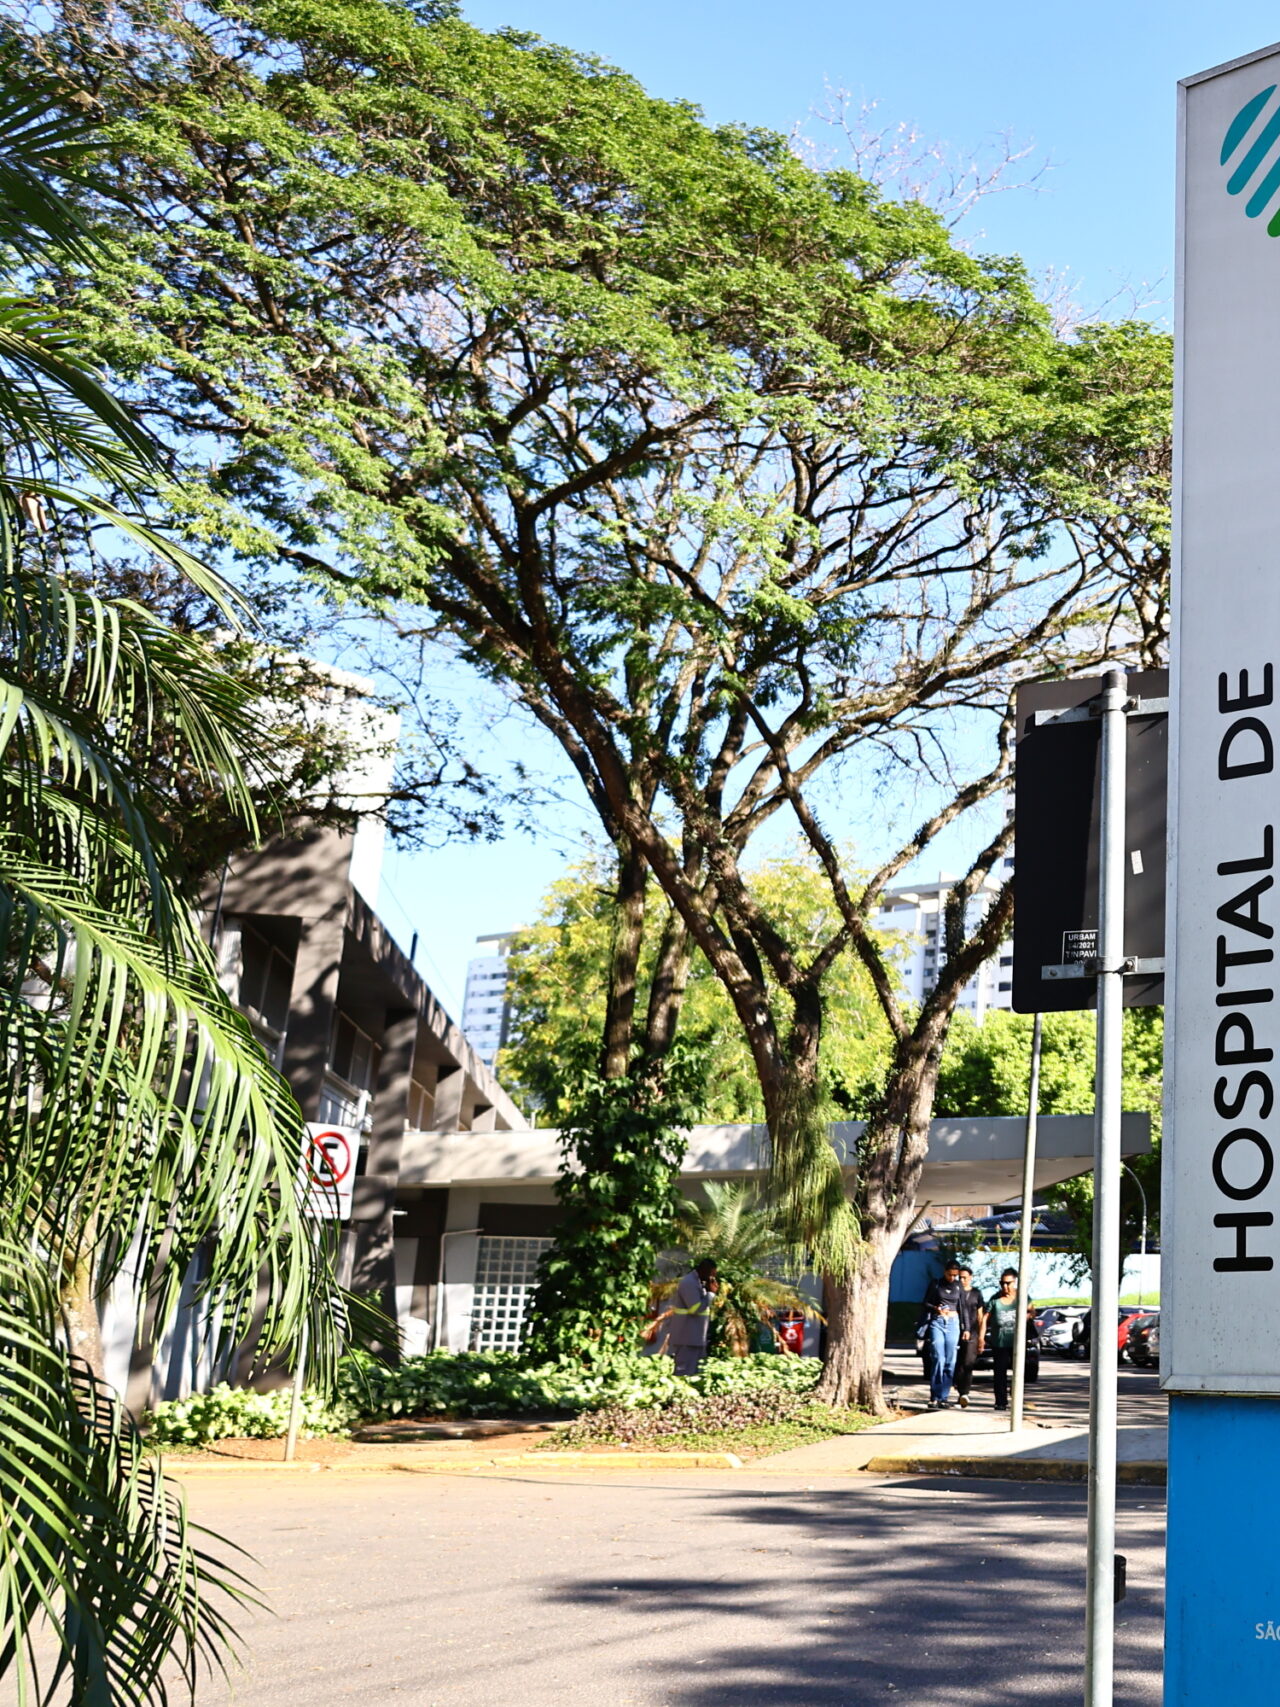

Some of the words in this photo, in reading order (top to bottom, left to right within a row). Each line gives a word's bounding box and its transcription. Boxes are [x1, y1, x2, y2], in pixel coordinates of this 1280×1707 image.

[1218, 662, 1274, 781] DE
[1068, 932, 1096, 941] URBAM
[1212, 824, 1274, 1273] HOSPITAL
